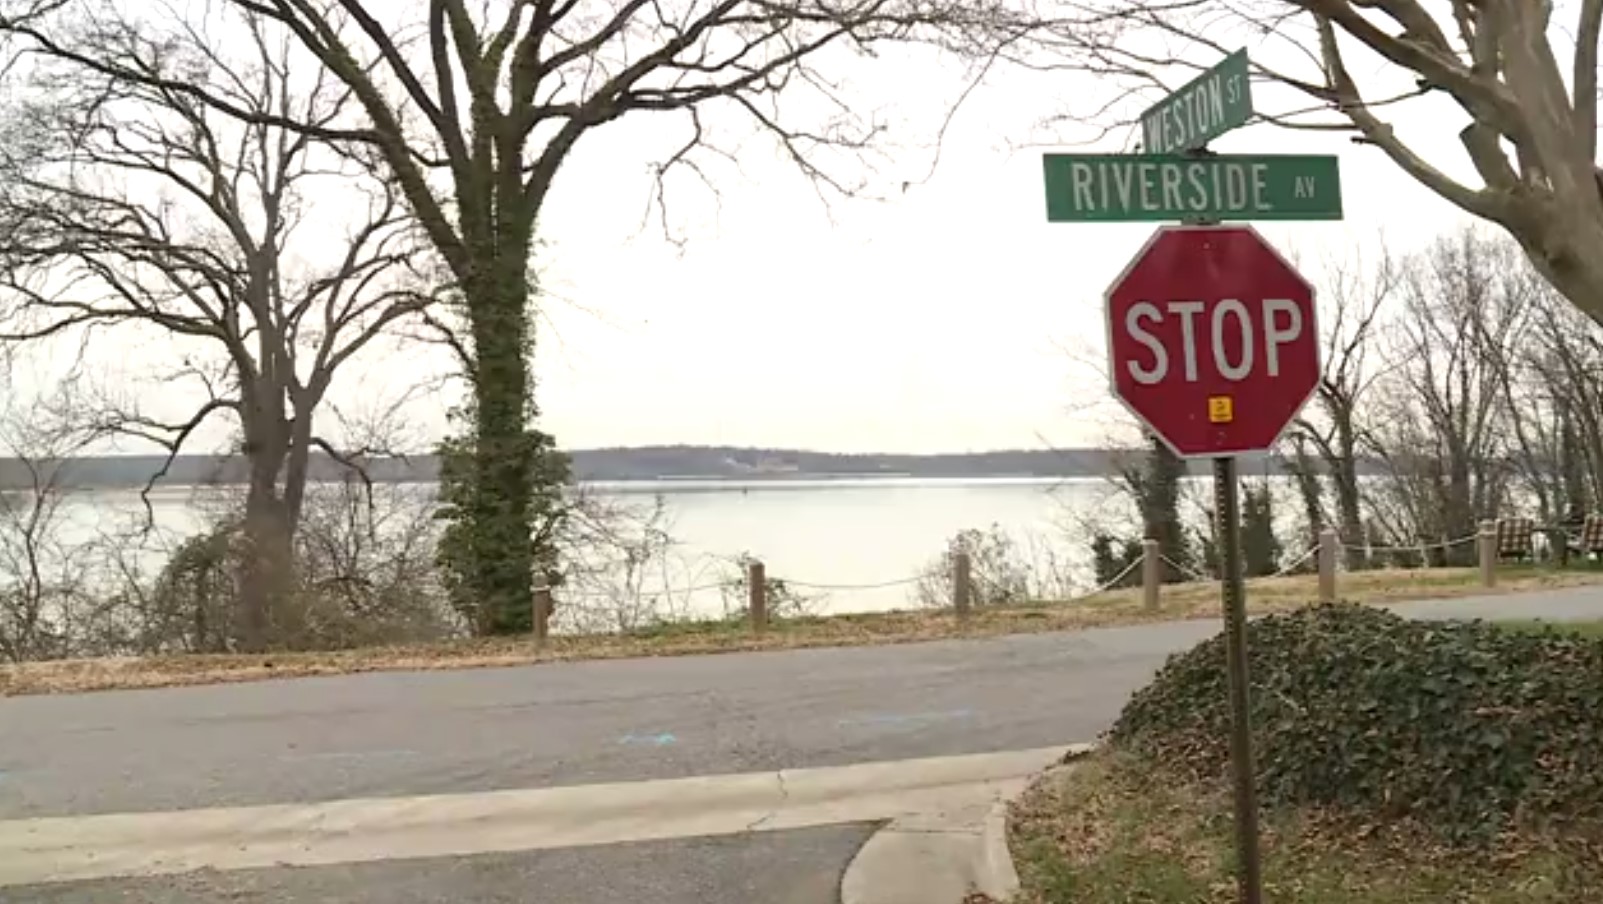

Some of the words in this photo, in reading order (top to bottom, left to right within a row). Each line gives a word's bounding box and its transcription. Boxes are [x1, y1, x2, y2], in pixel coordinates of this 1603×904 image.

[1146, 73, 1224, 153] WESTON
[1227, 74, 1241, 104] ST
[1071, 163, 1273, 213] RIVERSIDE
[1295, 176, 1315, 198] AV
[1125, 299, 1303, 384] STOP
